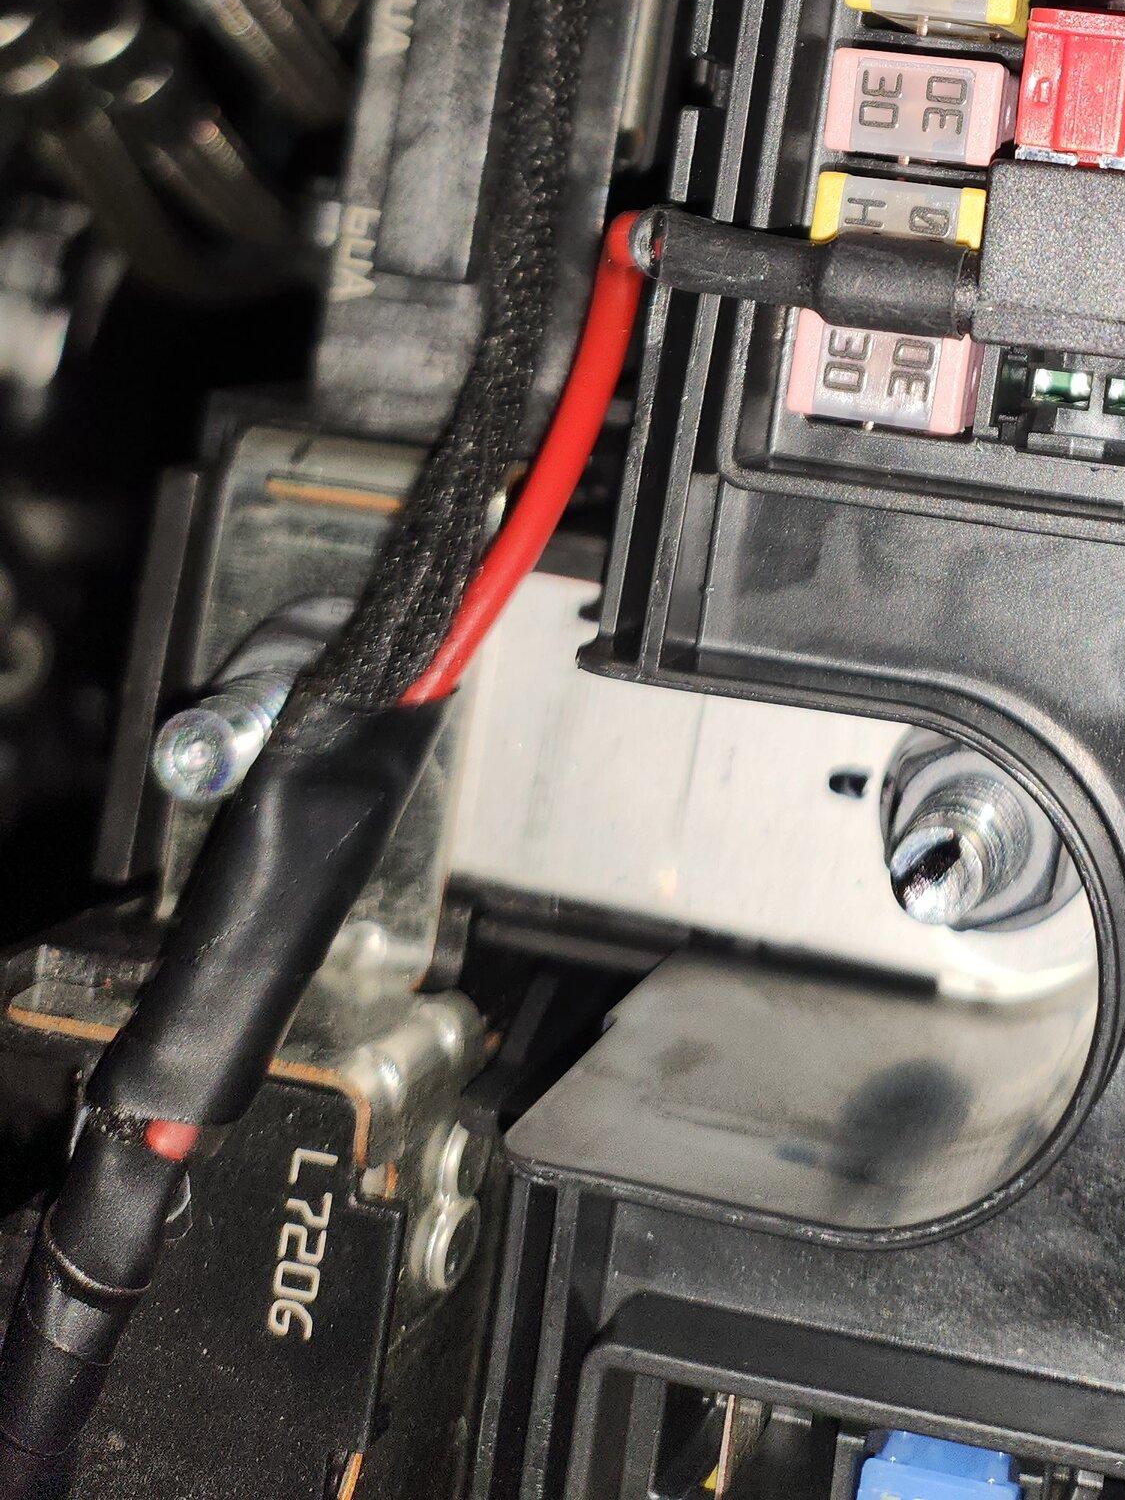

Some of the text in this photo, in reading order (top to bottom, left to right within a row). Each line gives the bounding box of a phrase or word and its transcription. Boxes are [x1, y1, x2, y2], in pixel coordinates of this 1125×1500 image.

[859, 70, 903, 129] 30
[922, 76, 967, 135] 30
[845, 197, 886, 229] H
[824, 329, 871, 393] 30
[887, 337, 935, 402] 30
